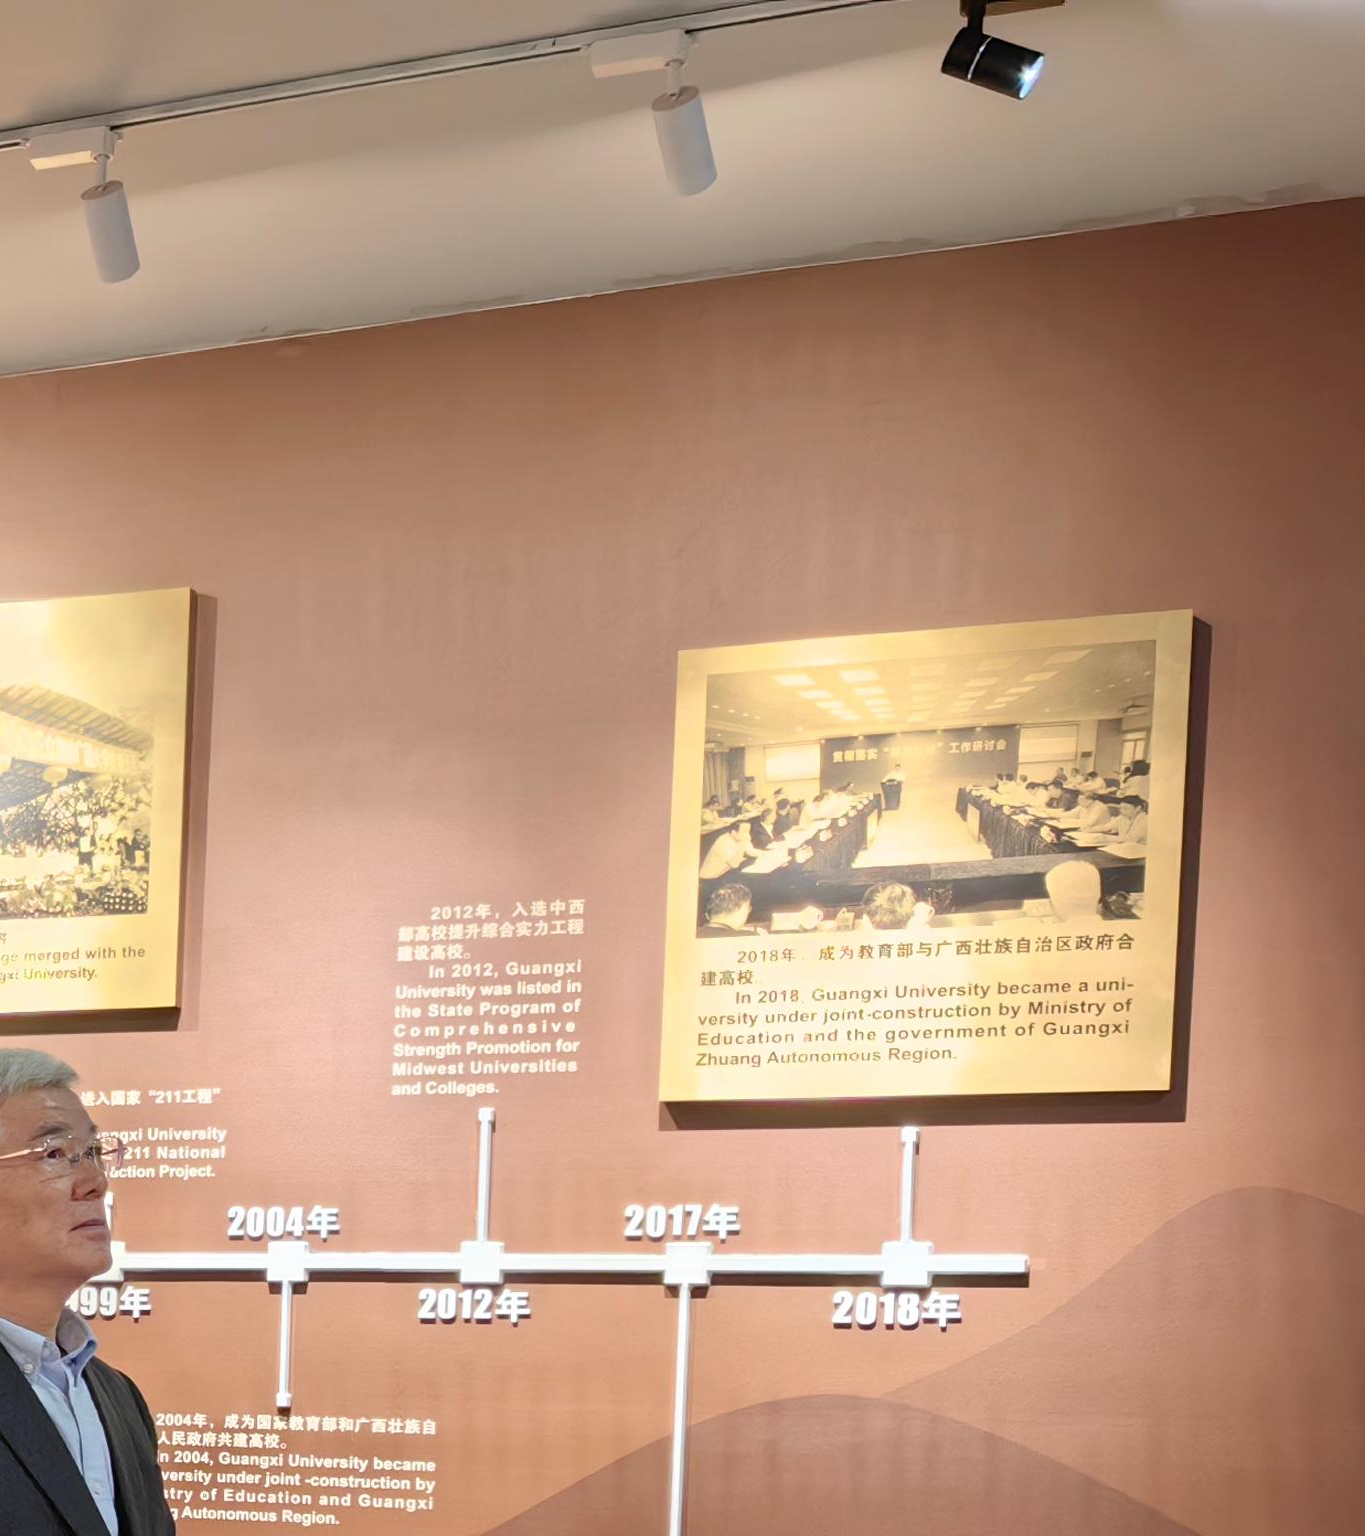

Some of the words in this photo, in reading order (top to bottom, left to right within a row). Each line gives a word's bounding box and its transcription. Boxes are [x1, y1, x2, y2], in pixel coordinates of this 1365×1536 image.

[24, 949, 80, 964] merged
[85, 947, 116, 959] with
[122, 946, 146, 958] the
[23, 967, 97, 981] University.
[428, 965, 445, 979] In
[505, 959, 582, 977] Guangxi
[395, 984, 476, 1000] University
[479, 984, 512, 996] was
[516, 980, 562, 995] listed
[566, 979, 582, 993] in
[736, 991, 751, 1004] In
[811, 988, 888, 1003] Guangxi
[895, 983, 991, 999] University
[997, 982, 1071, 995] became
[1078, 981, 1088, 993] a
[1096, 978, 1134, 992] uni-
[394, 1005, 422, 1019] the
[427, 1003, 474, 1018] State
[479, 1001, 556, 1018] Program
[561, 998, 582, 1013] of
[698, 1013, 758, 1027] versity
[765, 1010, 818, 1024] under
[998, 1002, 1021, 1019] by
[1028, 1001, 1106, 1016] Ministry
[1112, 998, 1133, 1013] of
[393, 1020, 576, 1039] Comprehensive
[697, 1032, 795, 1046] Education
[805, 1029, 838, 1042] and
[846, 1028, 877, 1041] the
[885, 1025, 1006, 1043] government
[1014, 1022, 1035, 1037] of
[1043, 1020, 1129, 1038] Guangxi
[392, 1042, 462, 1059] Strength
[465, 1040, 552, 1055] Promotion
[555, 1038, 580, 1053] for
[695, 1053, 761, 1068] Zhuang
[767, 1051, 881, 1064] Autonomous
[888, 1047, 956, 1064] Region.
[392, 1062, 464, 1076] Midwest
[469, 1059, 578, 1074] Universities
[391, 1081, 422, 1096] and
[425, 1081, 500, 1097] Colleges.
[227, 1205, 340, 1240] 2004年
[624, 1204, 741, 1241] 2017年
[417, 1289, 531, 1324] 2012年
[832, 1291, 962, 1328] 2018年
